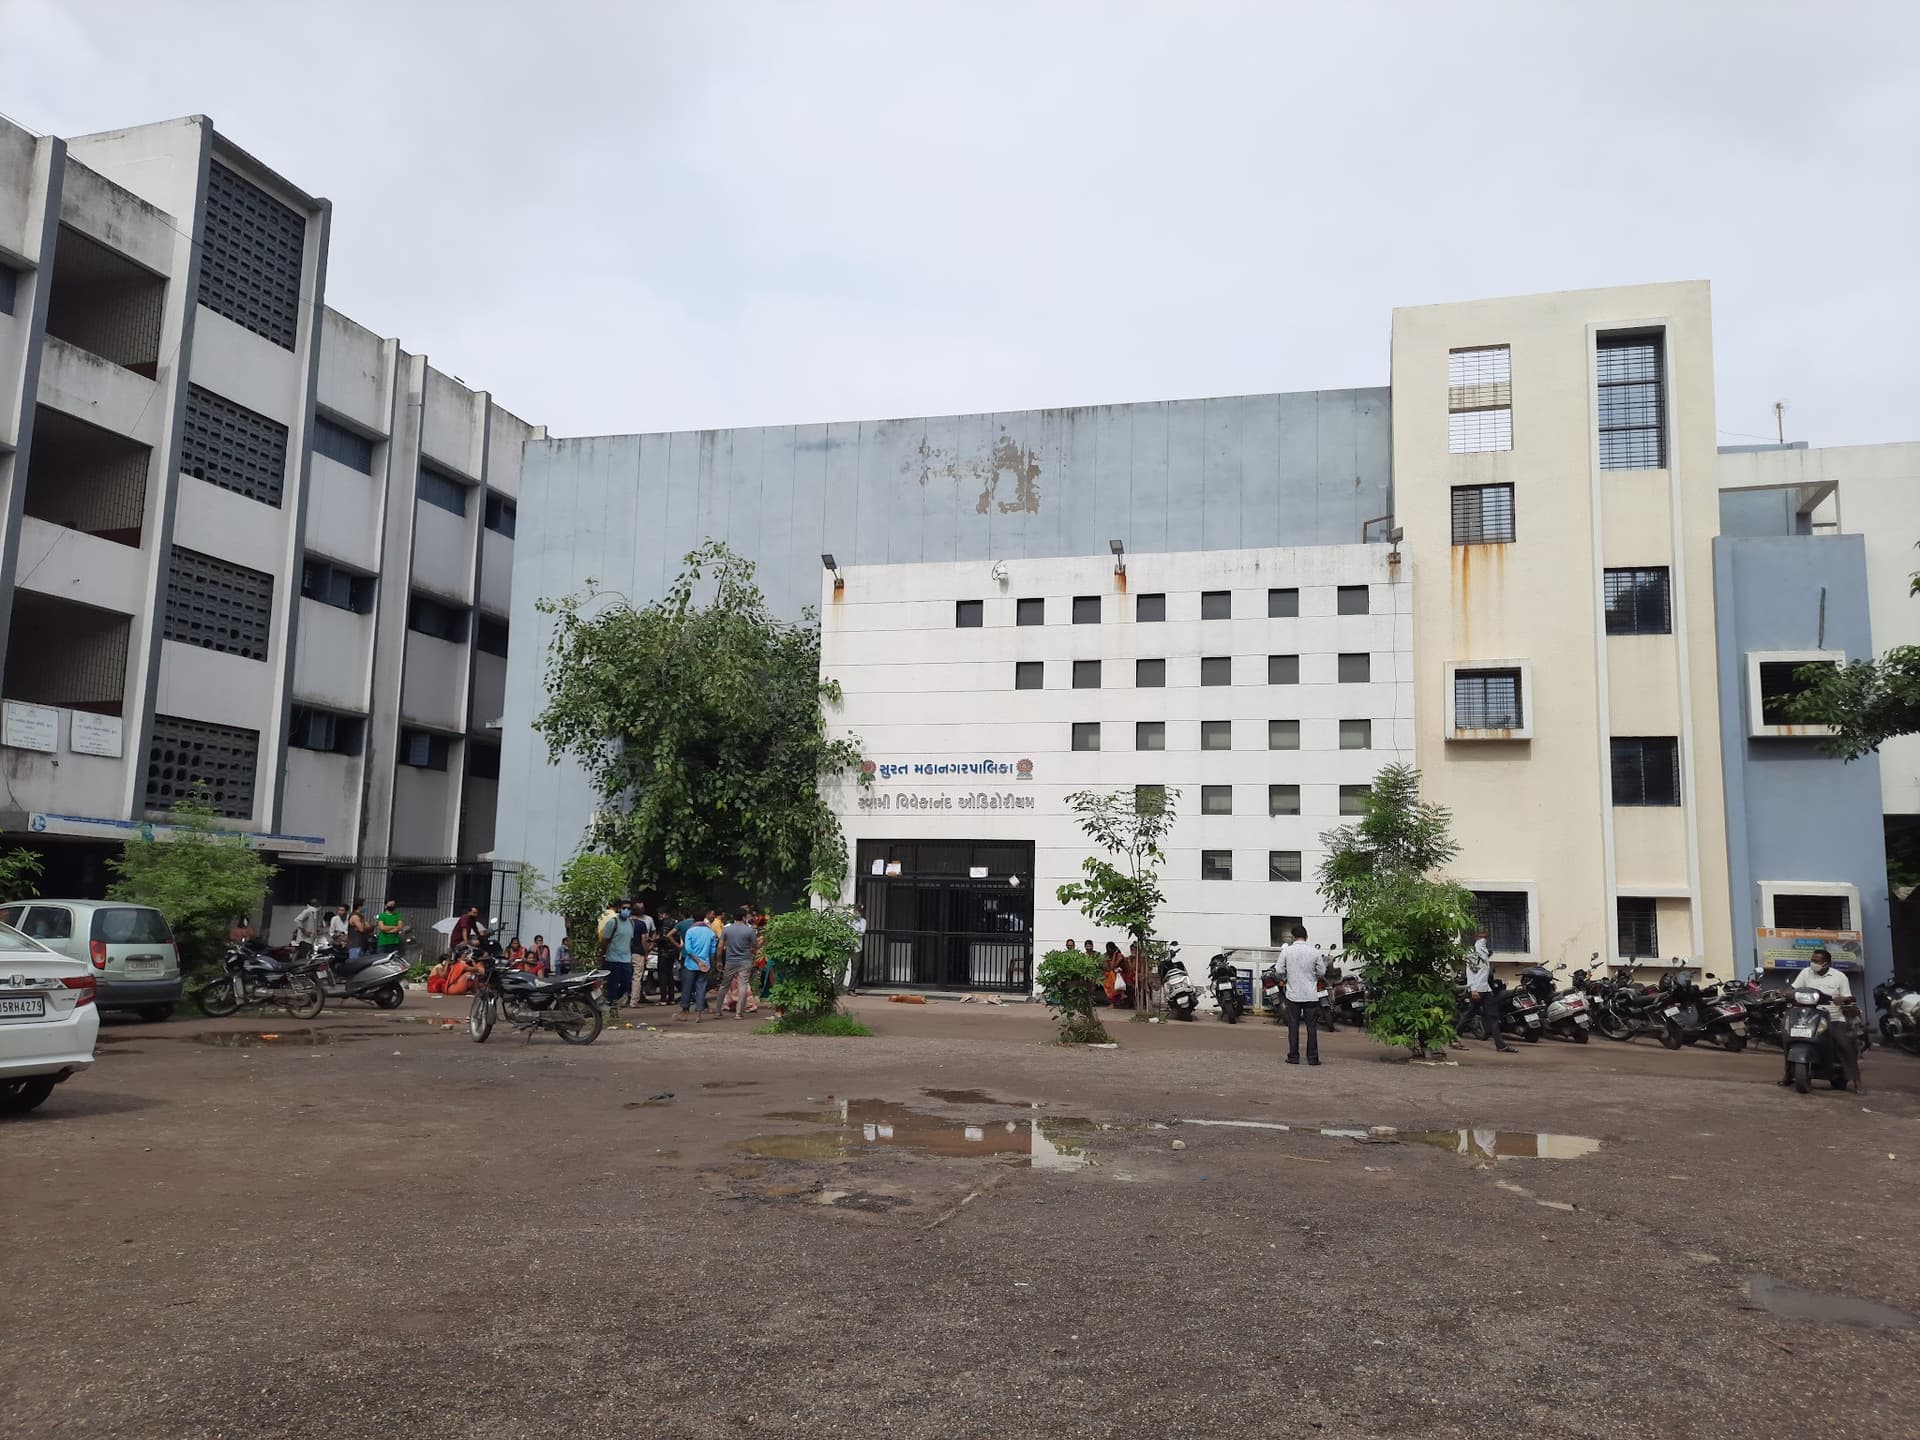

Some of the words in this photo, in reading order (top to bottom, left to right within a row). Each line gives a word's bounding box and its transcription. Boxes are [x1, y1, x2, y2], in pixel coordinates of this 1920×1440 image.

[880, 764, 908, 779] સુરત
[914, 759, 1013, 775] મહાનગરપાલિકા
[896, 792, 952, 809] વિવેકાનંદ
[958, 792, 1035, 809] ઓડિટોરીયમ
